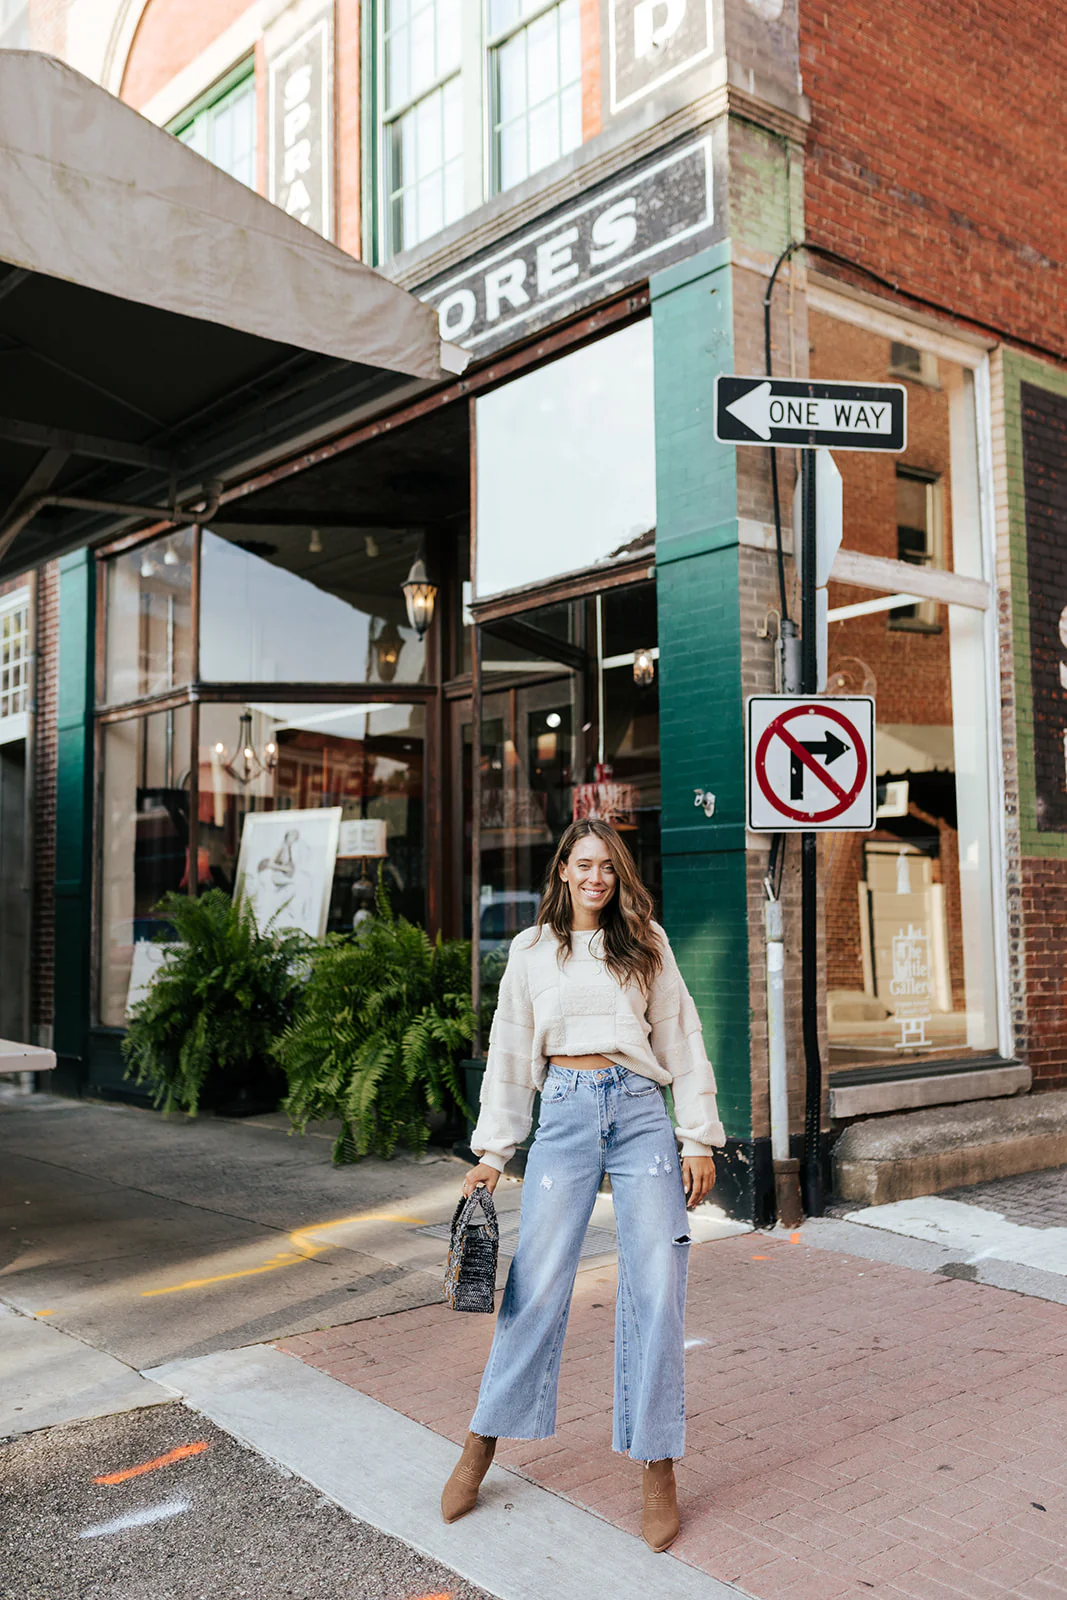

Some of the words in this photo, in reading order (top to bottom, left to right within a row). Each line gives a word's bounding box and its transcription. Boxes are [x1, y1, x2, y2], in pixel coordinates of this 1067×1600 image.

[769, 400, 819, 426] ONE
[834, 404, 886, 429] WAY
[897, 941, 922, 961] The
[889, 978, 932, 1000] Gallery
